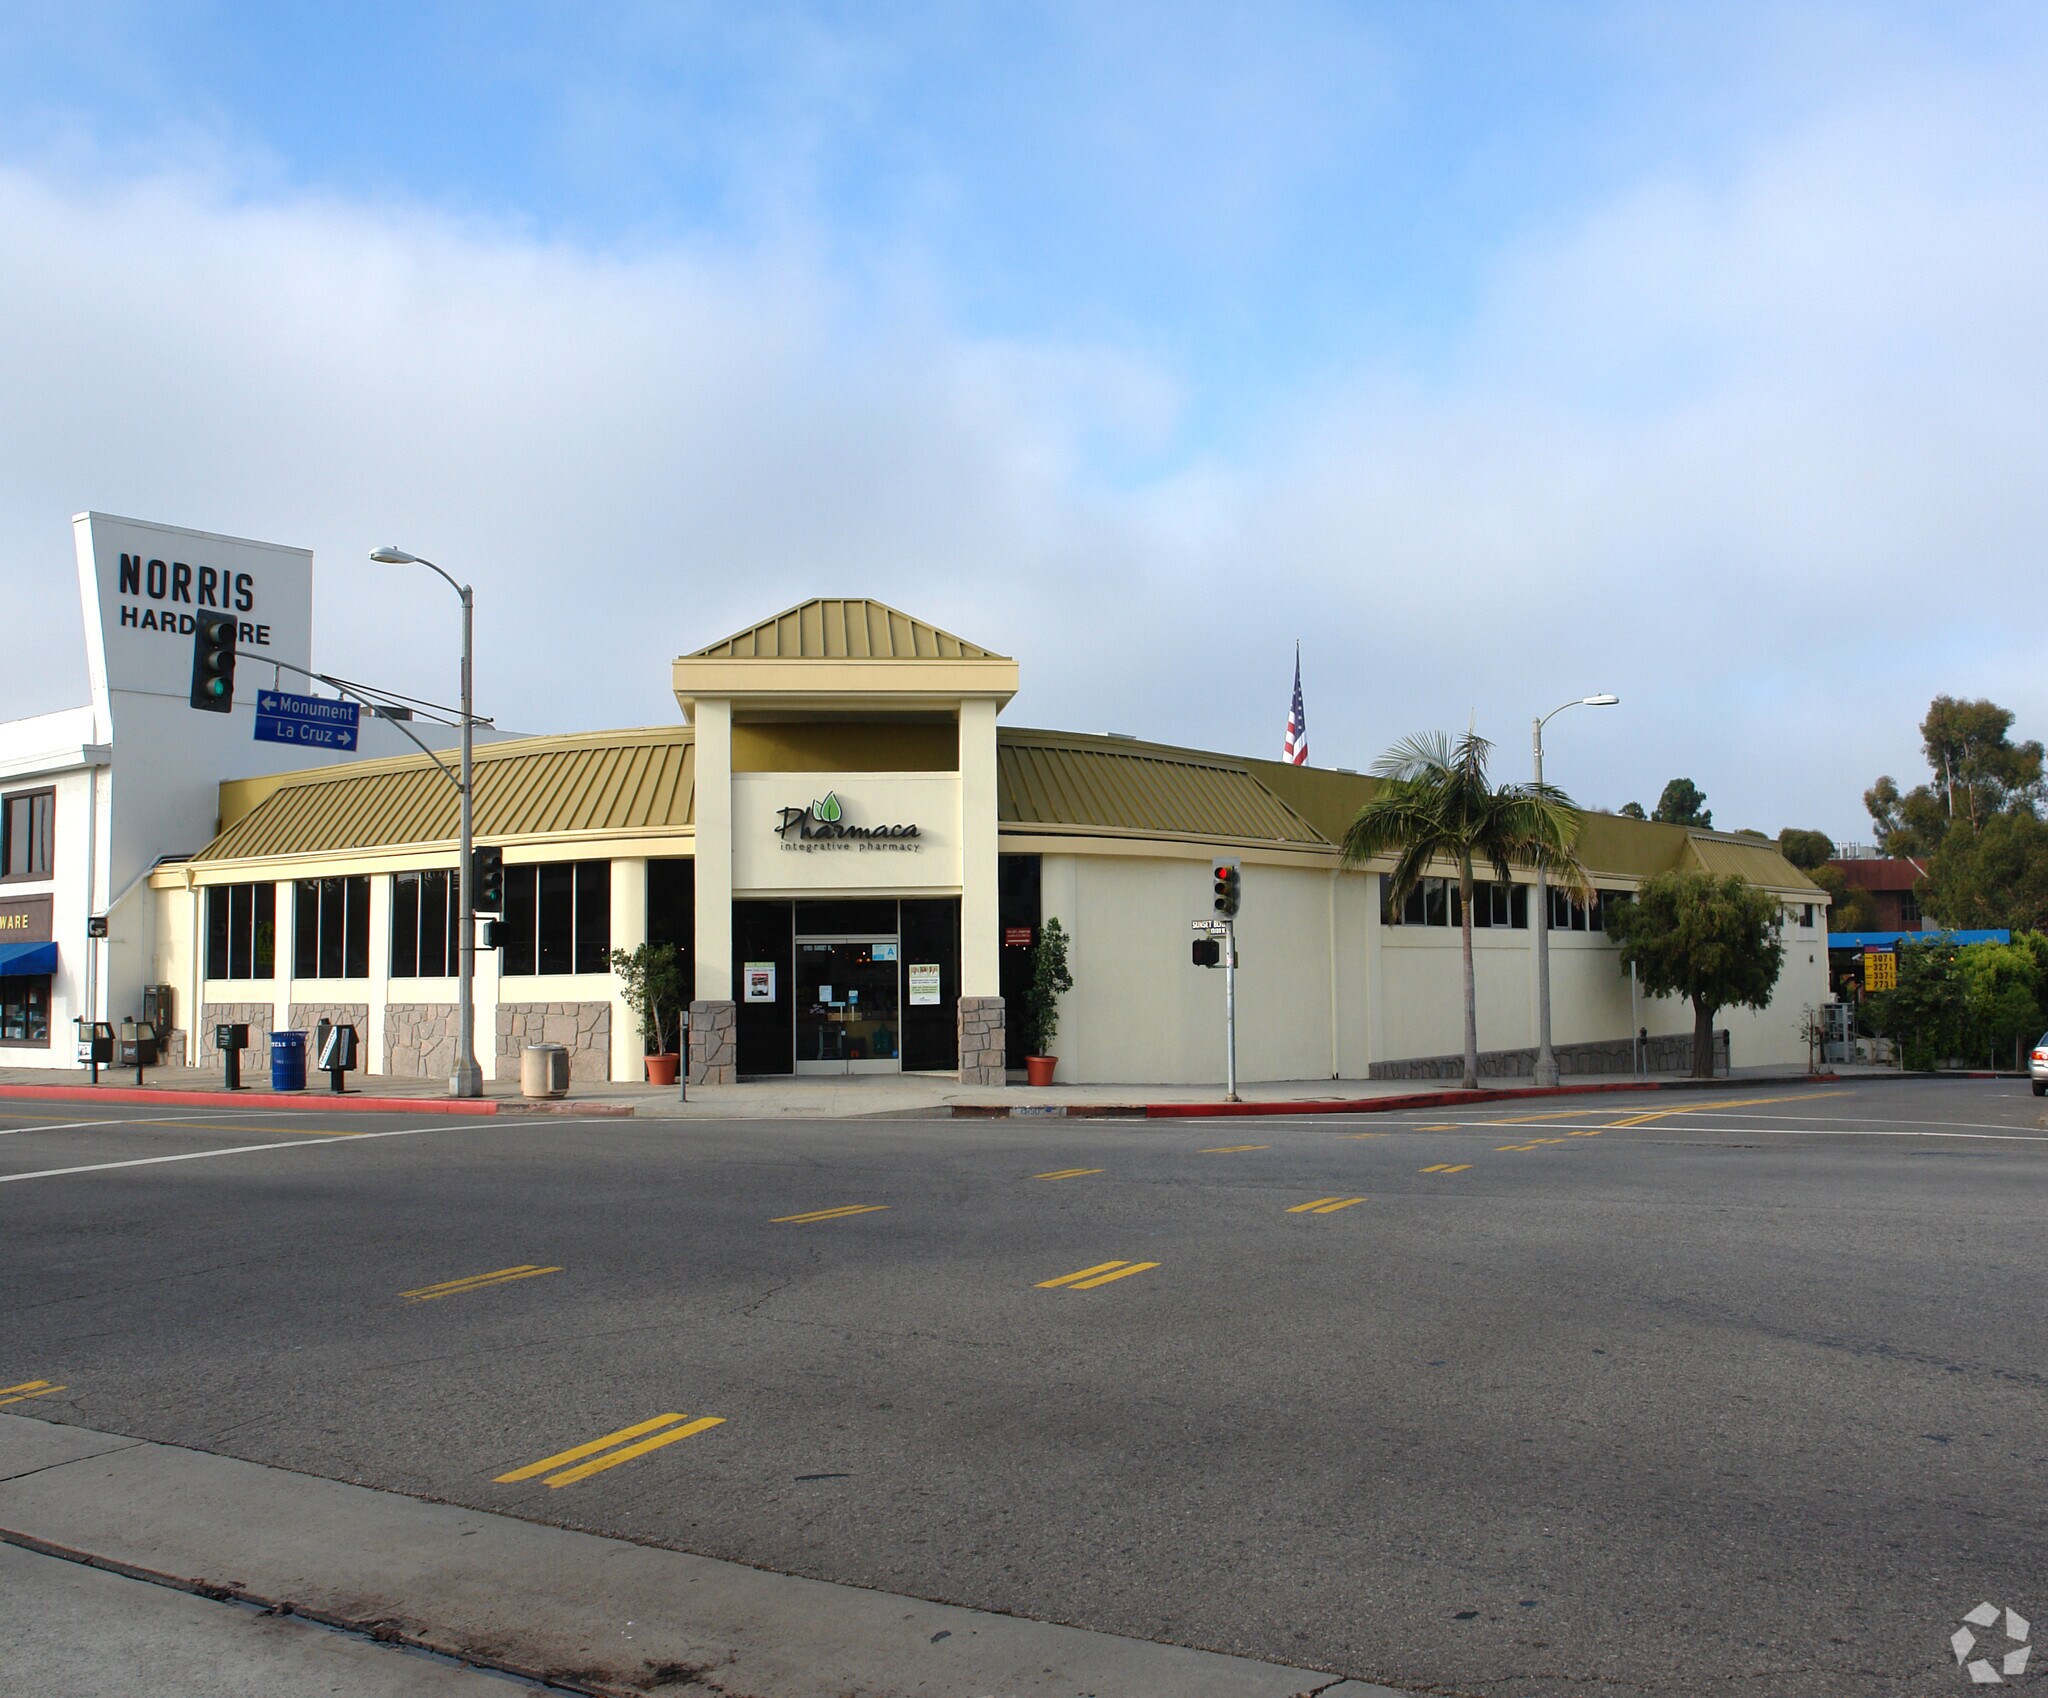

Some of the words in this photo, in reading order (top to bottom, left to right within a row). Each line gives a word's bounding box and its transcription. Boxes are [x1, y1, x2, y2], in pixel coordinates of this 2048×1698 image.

[120, 553, 254, 612] NORRIS
[120, 605, 271, 646] HARDRE
[280, 696, 354, 720] Monument
[277, 721, 294, 738] La
[300, 724, 333, 743] Cruz
[774, 806, 921, 840] Pharmaca
[780, 841, 850, 853] integrative
[859, 842, 920, 853] pharmacy
[1192, 920, 1212, 929] SUNSET
[1872, 954, 1888, 962] 307
[1873, 963, 1889, 971] 327
[1873, 971, 1889, 980] 337
